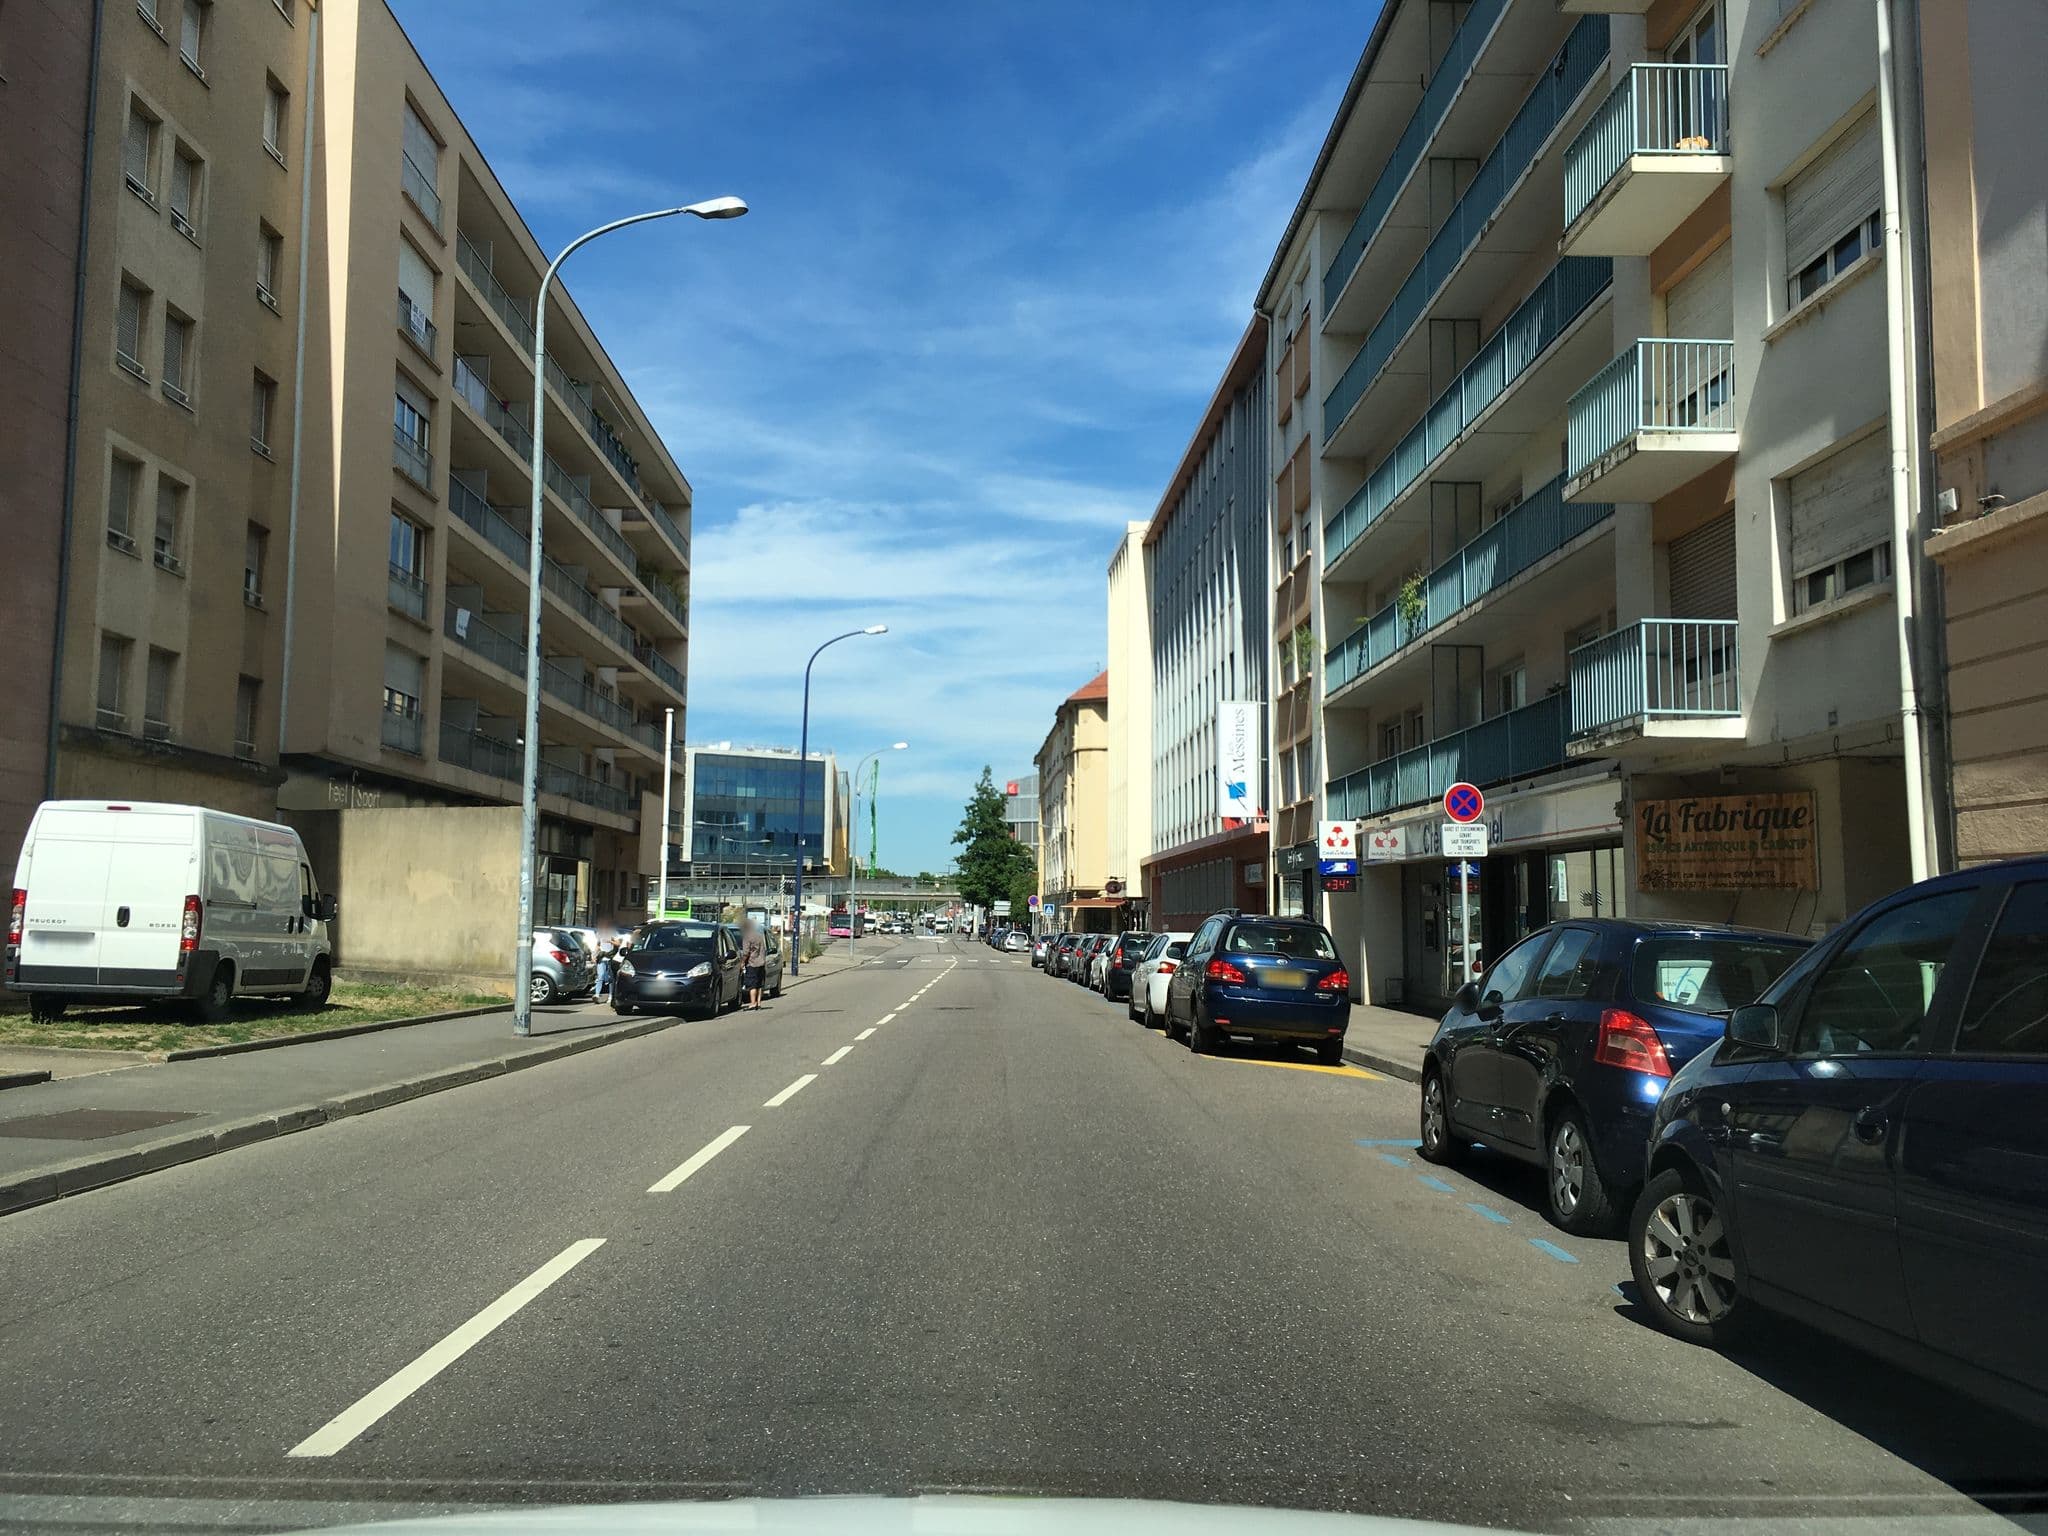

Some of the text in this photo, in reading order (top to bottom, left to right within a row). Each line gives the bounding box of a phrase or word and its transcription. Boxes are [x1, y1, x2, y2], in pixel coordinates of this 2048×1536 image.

[1233, 708, 1245, 773] Messines
[1641, 800, 1808, 843] La Fabrique
